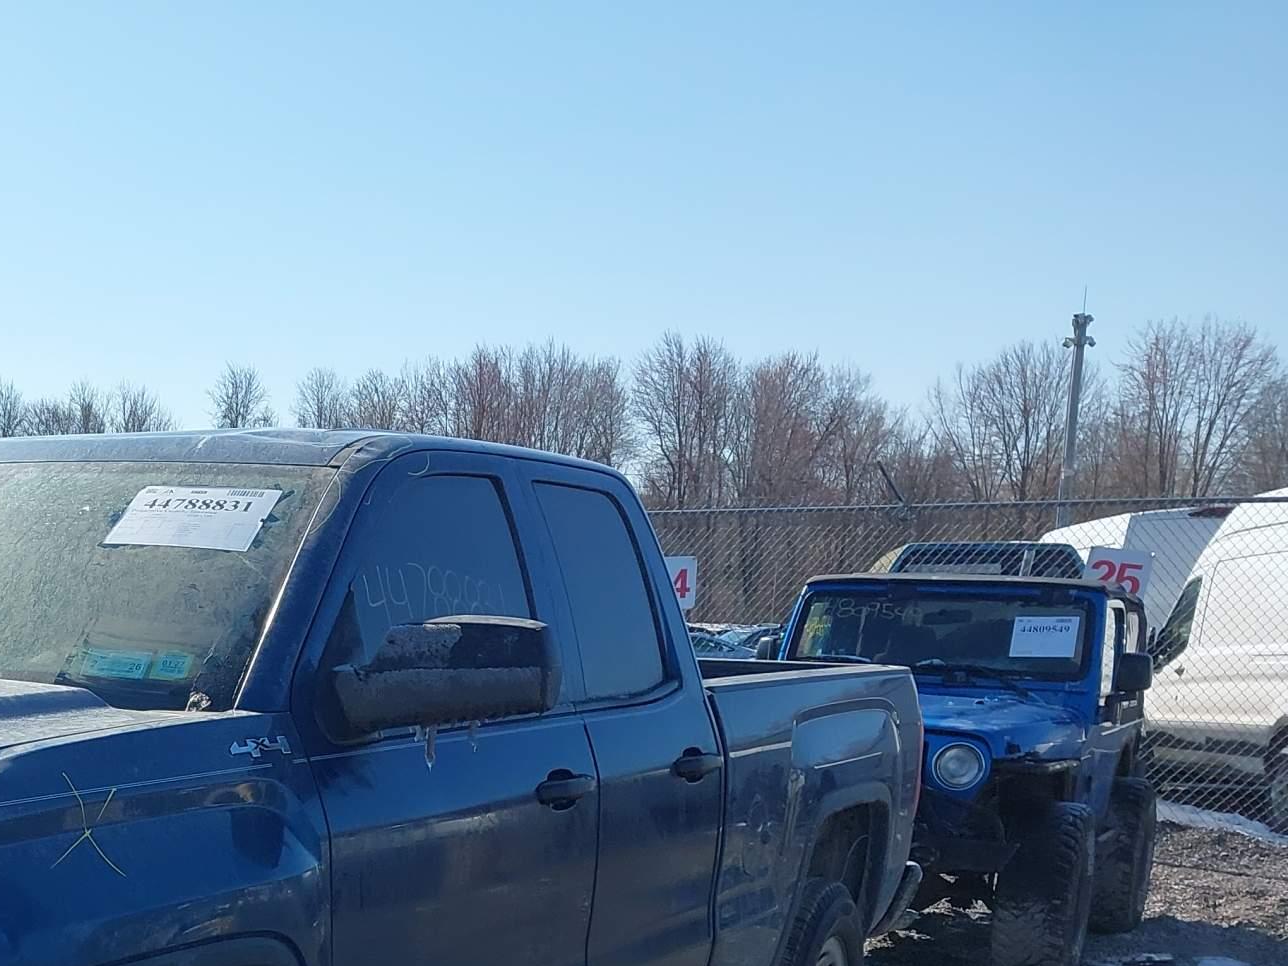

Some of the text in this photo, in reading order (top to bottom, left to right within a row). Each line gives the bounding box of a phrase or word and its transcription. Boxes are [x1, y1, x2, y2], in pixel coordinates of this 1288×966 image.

[143, 498, 253, 513] 44788831
[1091, 559, 1144, 593] 25
[1019, 624, 1071, 634] 44809549
